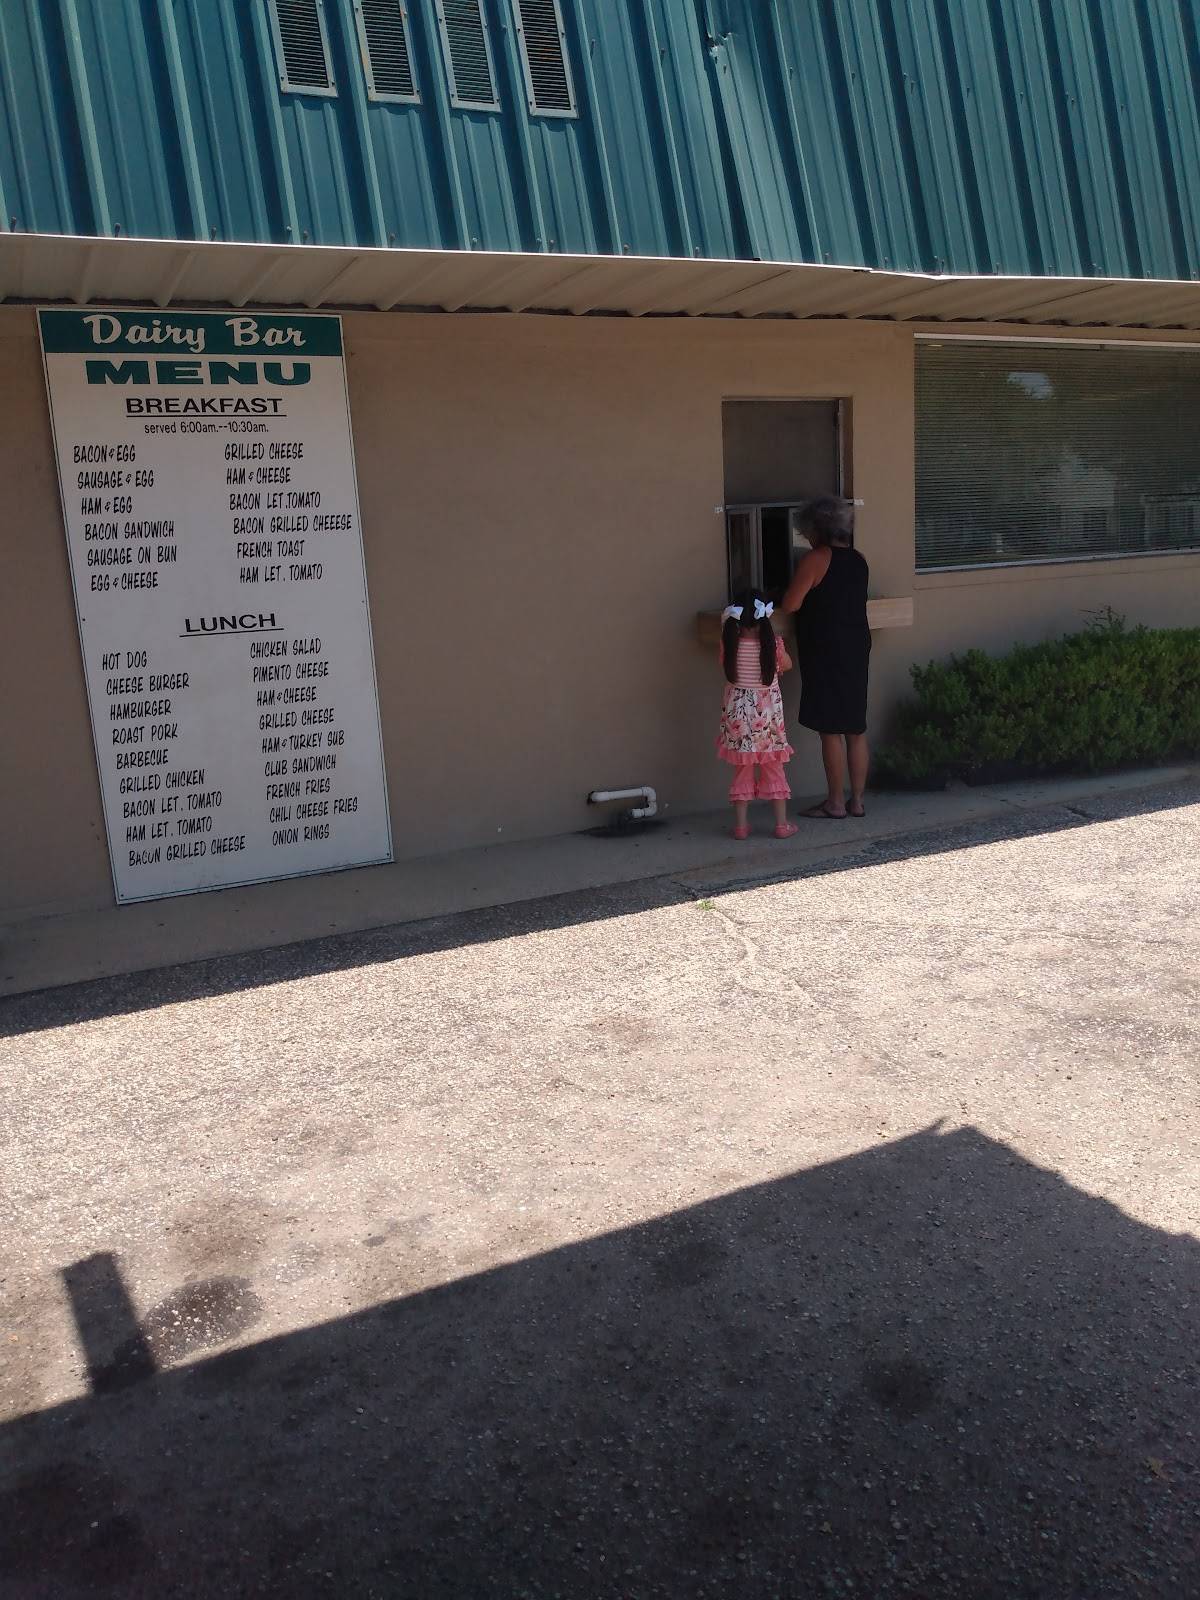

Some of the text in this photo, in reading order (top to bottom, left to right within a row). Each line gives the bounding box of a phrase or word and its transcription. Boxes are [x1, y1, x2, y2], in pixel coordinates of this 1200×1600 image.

[82, 314, 306, 353] Dairy Bar
[86, 359, 311, 385] MENU
[125, 397, 283, 414] BREAKFAST
[144, 421, 177, 435] served
[73, 444, 108, 463] BACON
[116, 444, 136, 462] EGG
[224, 442, 304, 461] GRILLED CHEESE
[77, 471, 124, 490] SAUSAGE
[135, 471, 155, 488] EGG
[226, 469, 246, 485] HAM
[256, 468, 291, 484] CHEESE
[81, 497, 103, 516] HAM
[112, 496, 133, 514] EGG
[229, 494, 261, 511] BACON
[84, 521, 175, 541] BACON SANDWICH
[233, 514, 352, 535] BACON GRILLED CHEEESE
[87, 545, 177, 567] SAUSAGE ON BUN
[236, 540, 305, 558] FRENCH TOAST
[90, 574, 111, 592] EGG
[121, 572, 159, 590] CHEESE
[239, 566, 259, 583] HAM
[288, 563, 323, 581] TOMATO
[184, 614, 277, 632] LUNCH
[250, 638, 322, 659] CHICKEN SALAD
[102, 650, 148, 670] HOT DOG
[253, 661, 329, 683] PIMENTO CHEESE
[106, 672, 190, 696] CHEESE BURGER
[256, 690, 276, 706] HAM
[283, 686, 317, 704] CHEESE
[110, 699, 172, 720] HAMBURGER
[259, 708, 335, 730] GRILLED CHEESE
[112, 723, 179, 745] ROAST PORK
[261, 737, 281, 754] HAM
[288, 733, 323, 751] TURKEY
[327, 730, 345, 746] SUB
[116, 749, 169, 769] BARBECUE
[264, 754, 337, 777] CLUB SANDWICH
[119, 769, 206, 794] GRILLED CHICKEN
[266, 778, 331, 800] FRENCH FRIES
[123, 799, 155, 818] BACON
[187, 791, 222, 810] TOMATO
[269, 796, 359, 823] CHILI CHEESE FRIES
[126, 824, 146, 843] HAM
[178, 816, 213, 836] TOMATO
[272, 824, 330, 846] ONION RINGS
[166, 840, 207, 861] GRILLED
[211, 835, 246, 856] CHEESE
